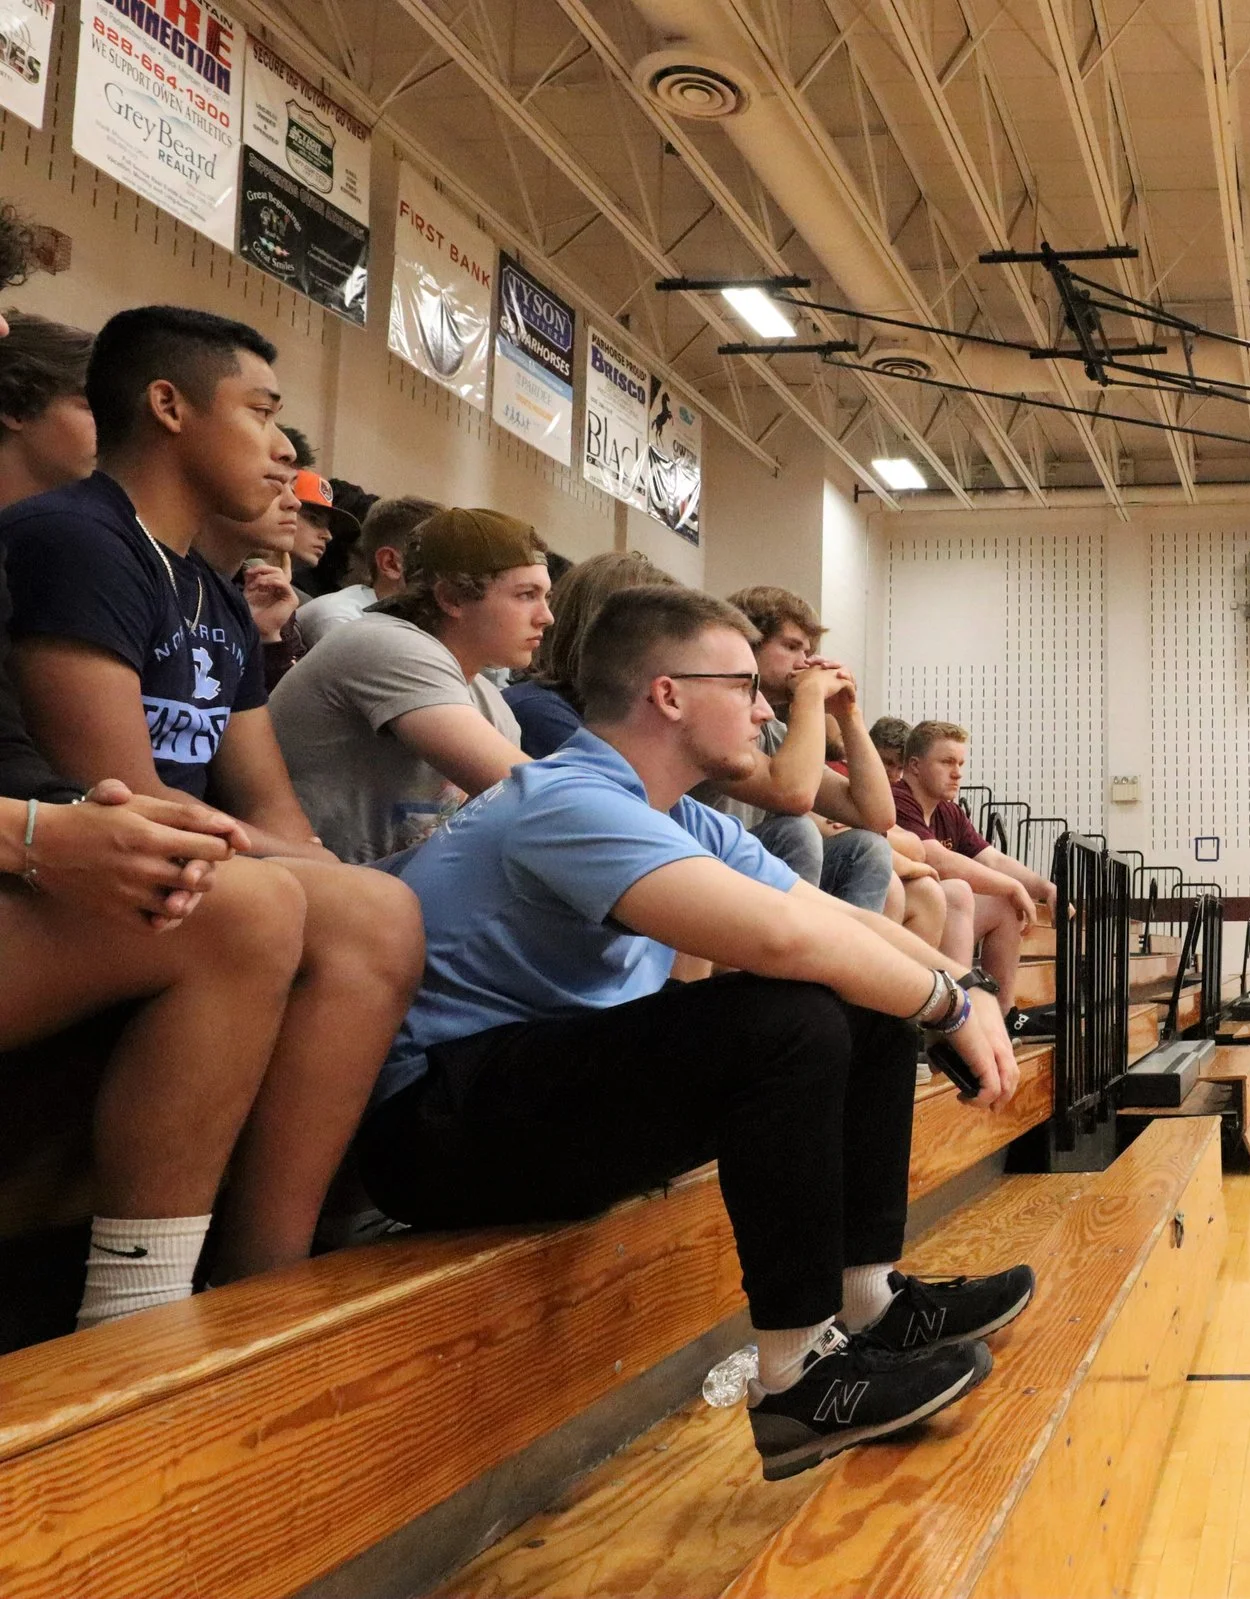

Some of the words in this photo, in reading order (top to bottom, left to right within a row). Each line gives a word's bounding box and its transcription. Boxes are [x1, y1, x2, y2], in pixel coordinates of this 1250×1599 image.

[104, 0, 230, 95] ONNECTION
[91, 33, 107, 56] WE
[109, 48, 151, 91] SUPPORT
[152, 80, 184, 114] OWEN
[186, 107, 233, 149] ATHLETICS
[93, 16, 230, 129] 828-664-1300
[253, 43, 284, 80] SECURE
[300, 78, 330, 116] VICTORY
[335, 109, 345, 128] GO
[158, 149, 200, 185] REALTY
[246, 190, 268, 201] Great
[268, 192, 302, 233] Beginnings
[252, 241, 271, 265] Great
[272, 258, 295, 272] Smiles
[400, 200, 445, 249] FIRST
[450, 243, 491, 289] BANK
[507, 271, 567, 336] TYSON
[518, 327, 571, 377] WARHORSES
[592, 333, 625, 367] WARHORSE
[922, 993, 940, 1016] FOUR
[902, 1307, 947, 1346] N
[813, 1380, 870, 1424] N
